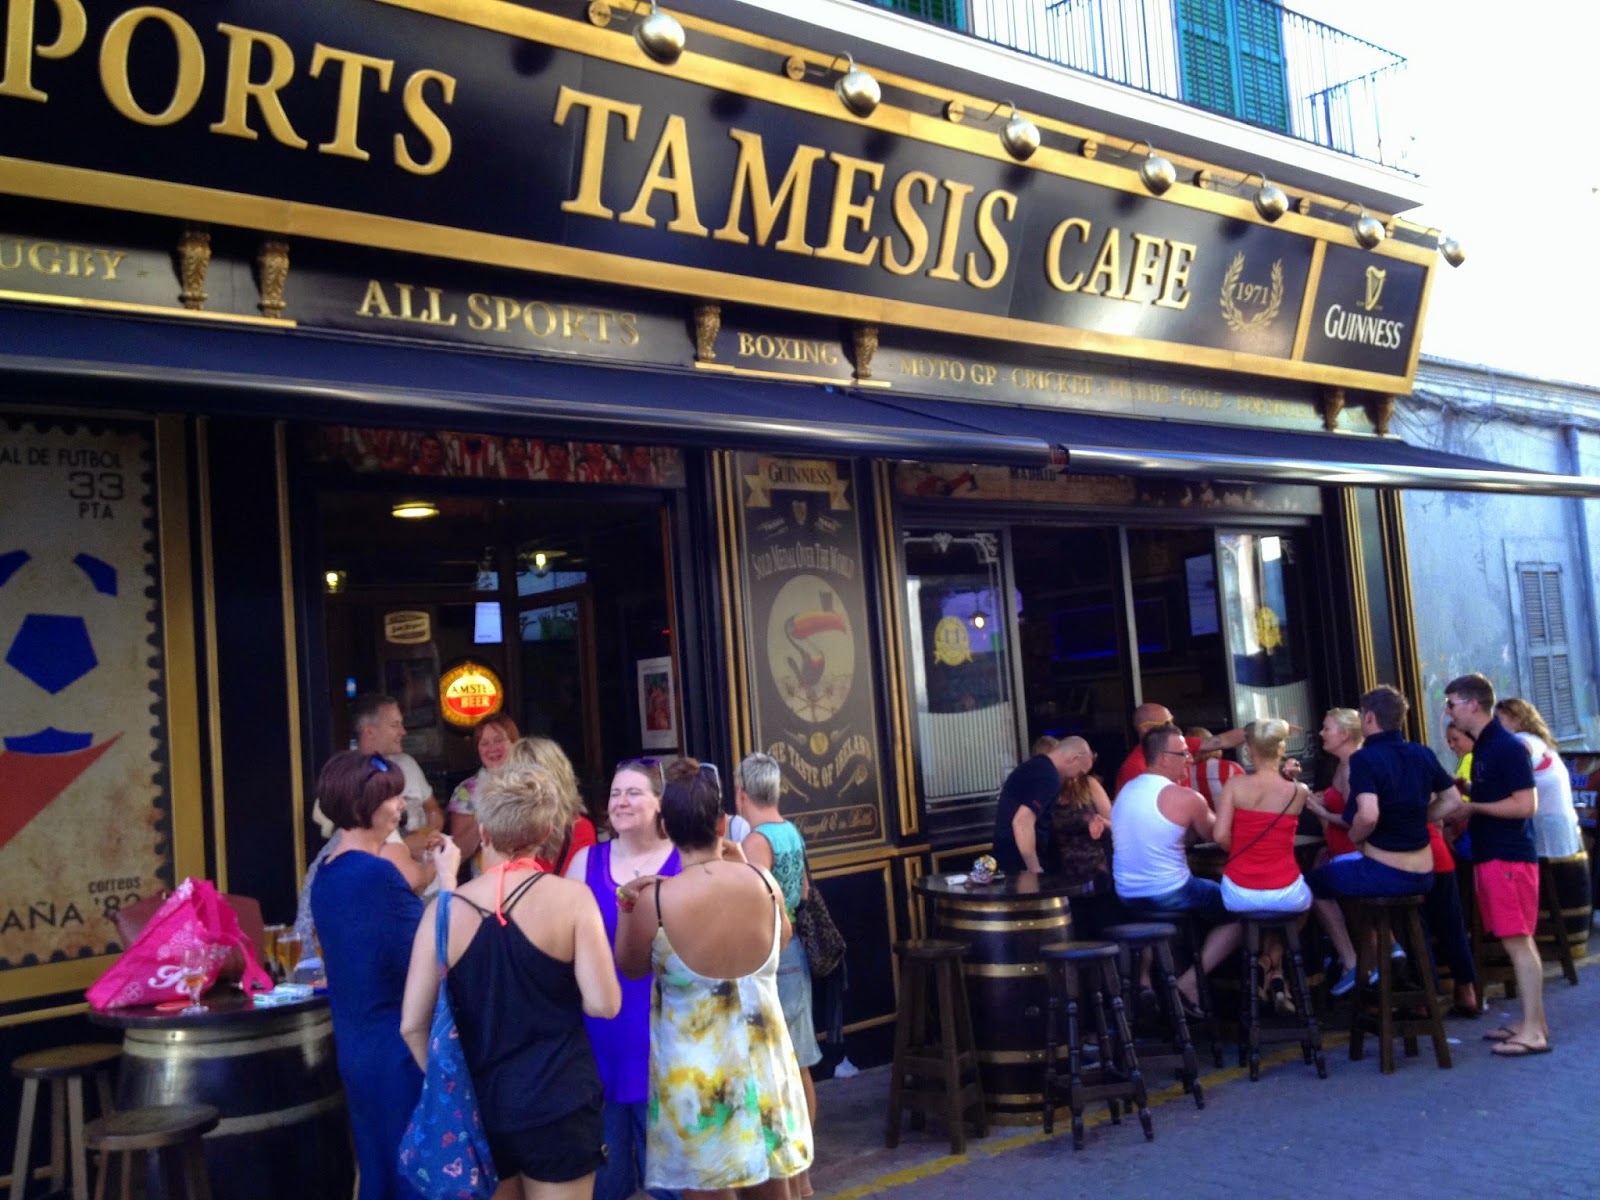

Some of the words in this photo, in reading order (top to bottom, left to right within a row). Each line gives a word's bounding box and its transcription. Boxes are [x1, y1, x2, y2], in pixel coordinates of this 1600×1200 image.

[0, 0, 456, 176] PORTS
[552, 85, 1018, 290] TAMESIS
[1046, 217, 1197, 310] CAFE
[0, 240, 128, 281] UGBY
[1236, 282, 1269, 305] 1971
[356, 279, 457, 326] ALL
[467, 291, 640, 346] SPORTS
[1324, 303, 1404, 350] GUINNESS
[737, 332, 838, 366] BOXING
[901, 356, 966, 382] MOTO
[970, 363, 997, 385] GP
[1011, 367, 1094, 395] CRICKET
[1181, 387, 1222, 409] GOLF
[28, 448, 48, 465] DE
[58, 449, 122, 469] FUTBOL
[768, 461, 832, 485] GUINNESS
[69, 471, 123, 500] 33
[79, 502, 114, 520] PTA
[461, 696, 490, 708] BEER
[788, 743, 820, 789] TASTE
[821, 763, 834, 788] OF
[88, 876, 141, 894] correos
[0, 901, 84, 934] AÑA
